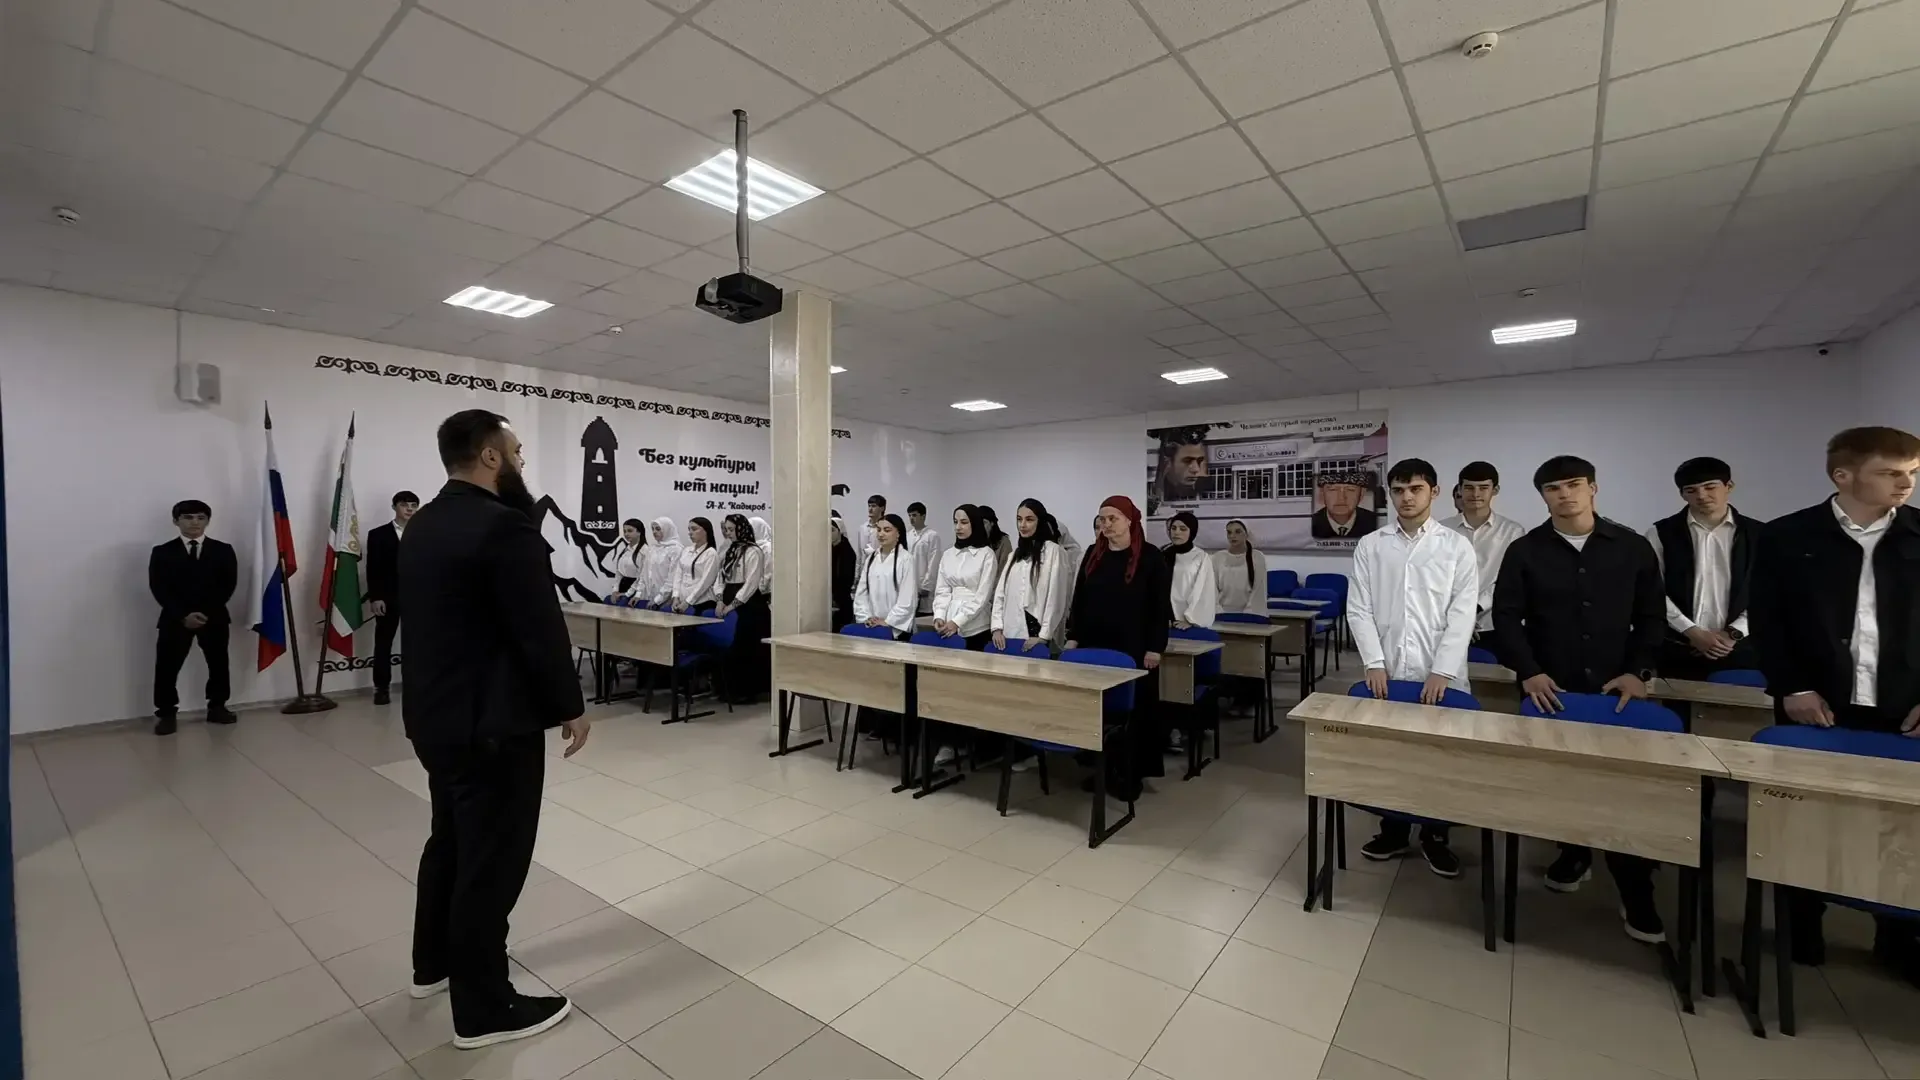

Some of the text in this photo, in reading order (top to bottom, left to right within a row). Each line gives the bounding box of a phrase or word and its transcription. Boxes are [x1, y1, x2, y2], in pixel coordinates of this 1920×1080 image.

[638, 448, 756, 474] Без культуры
[673, 477, 760, 498] нет нации!
[728, 501, 766, 512] Кадыров
